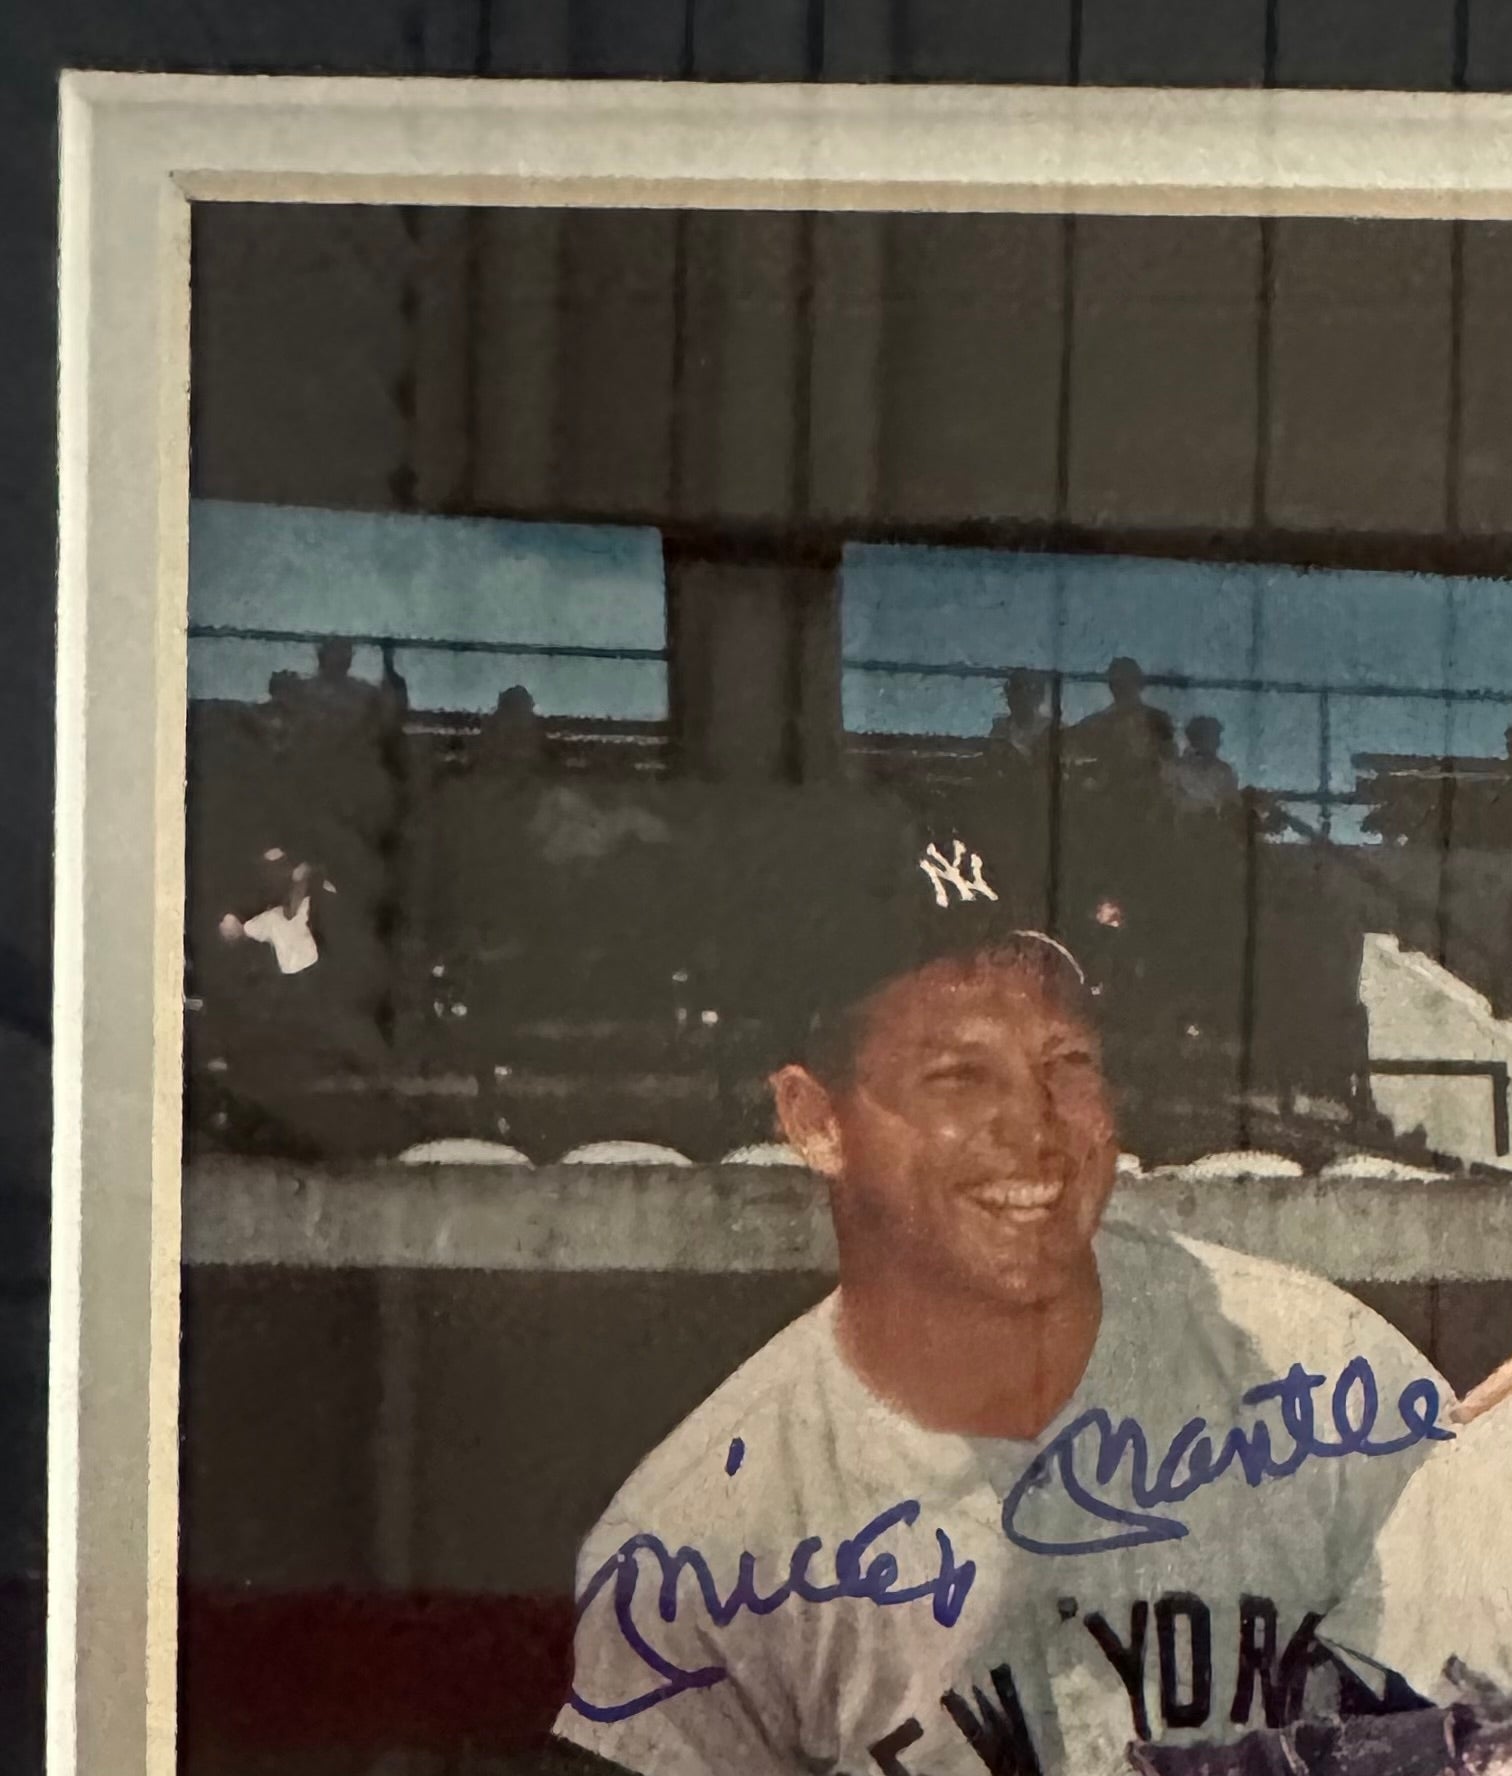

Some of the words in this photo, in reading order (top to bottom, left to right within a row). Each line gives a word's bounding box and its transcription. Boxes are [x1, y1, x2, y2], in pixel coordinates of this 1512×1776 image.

[919, 839, 999, 908] NY
[1001, 1355, 1456, 1556] Mantle
[1082, 1590, 1352, 1743] YORK
